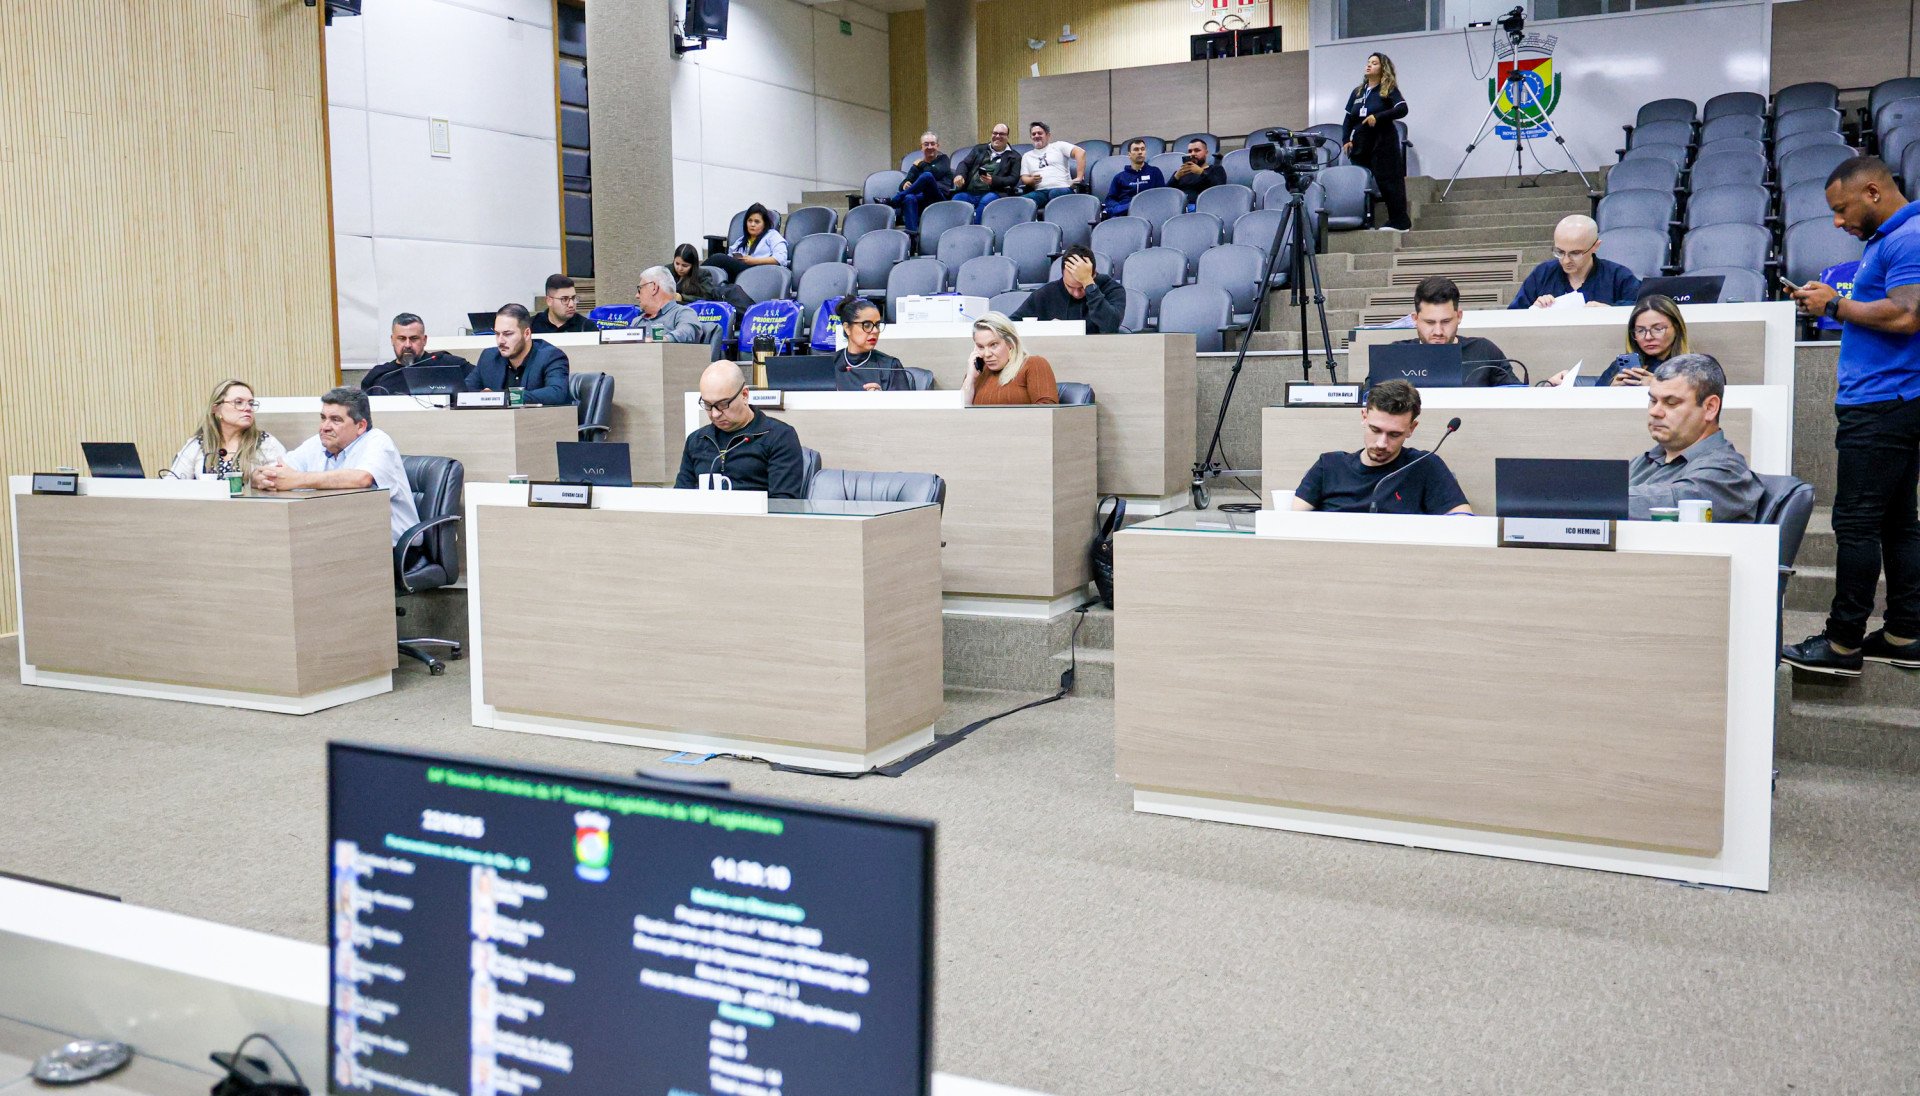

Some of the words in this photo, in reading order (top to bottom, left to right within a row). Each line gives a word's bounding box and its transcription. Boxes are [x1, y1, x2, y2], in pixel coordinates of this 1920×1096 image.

[583, 467, 605, 475] VAIO
[1565, 527, 1576, 535] ICO
[1577, 527, 1601, 536] HEMING
